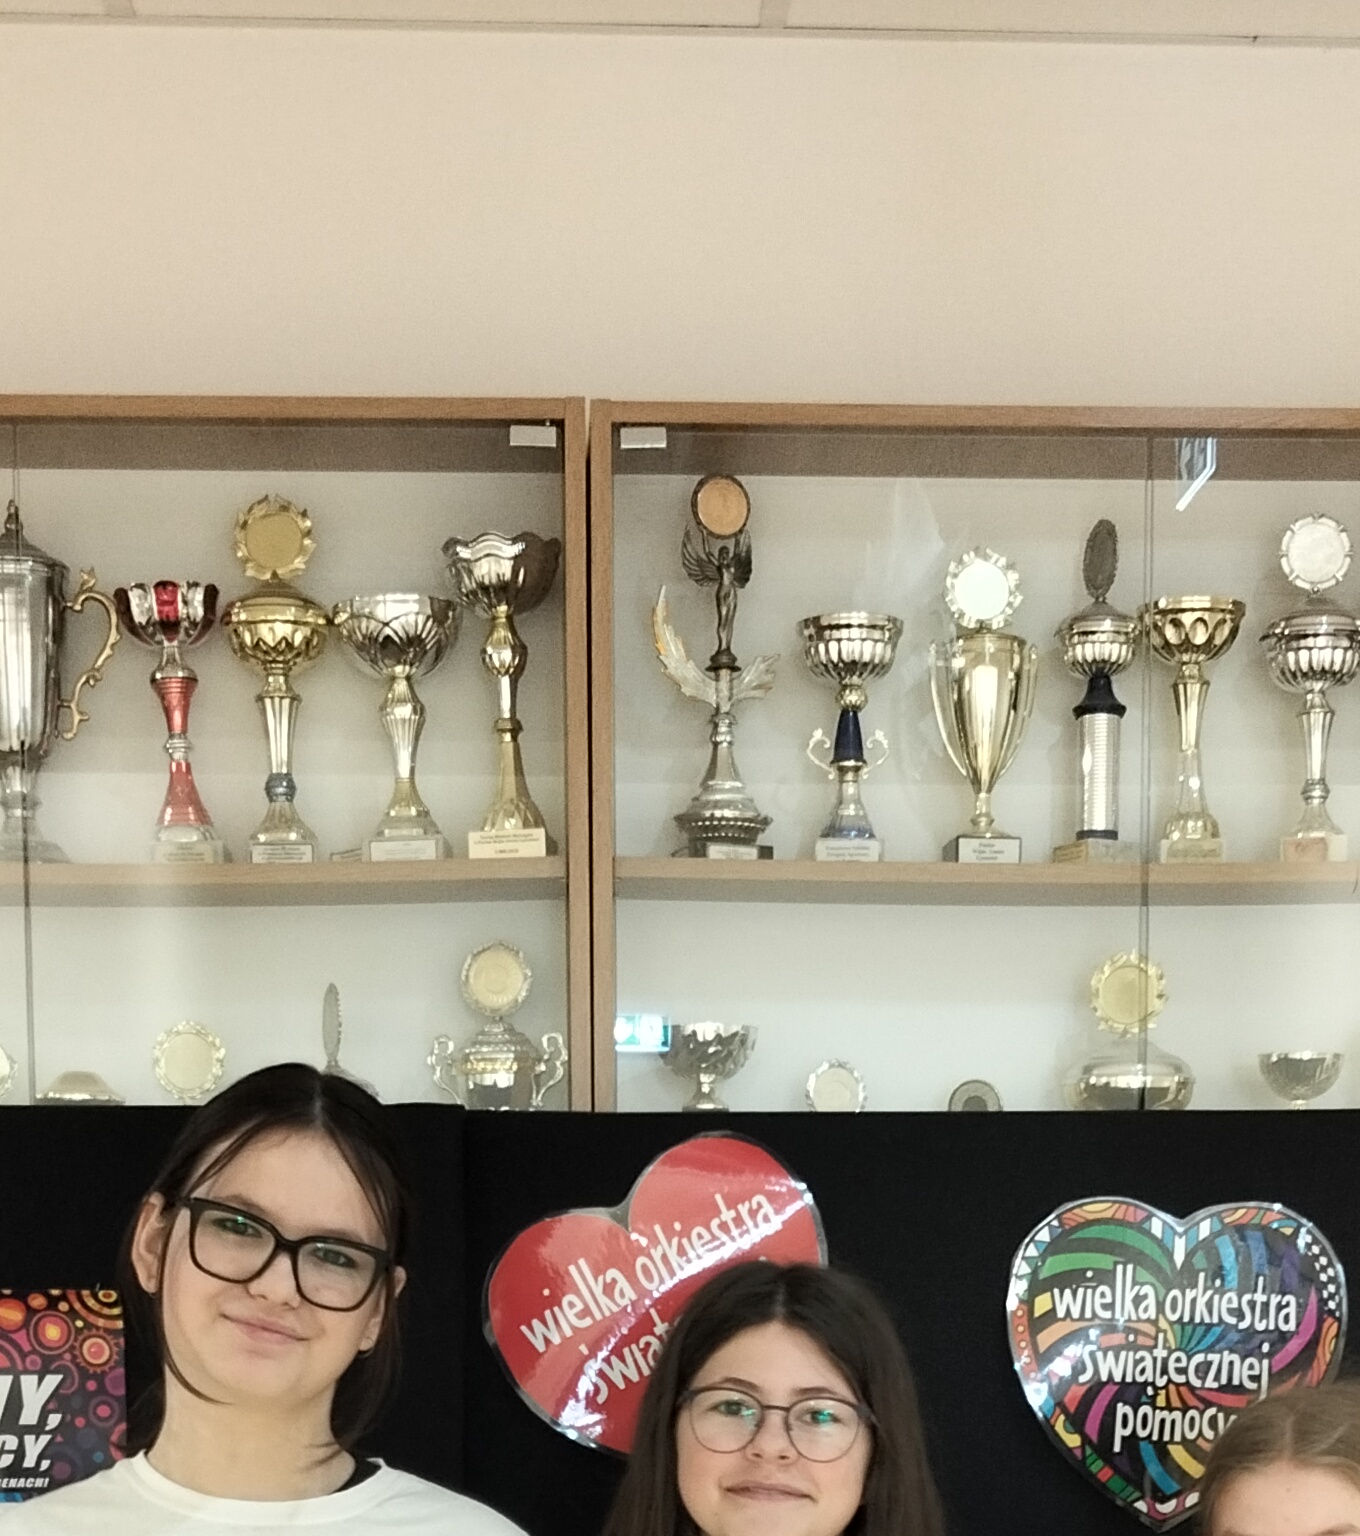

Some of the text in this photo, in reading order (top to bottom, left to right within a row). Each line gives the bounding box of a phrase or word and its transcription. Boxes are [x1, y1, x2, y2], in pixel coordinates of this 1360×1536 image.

[520, 1193, 778, 1353] wielka orkiestra
[1053, 1264, 1297, 1332] wielka orkiestra
[1078, 1328, 1270, 1401] świątecznej
